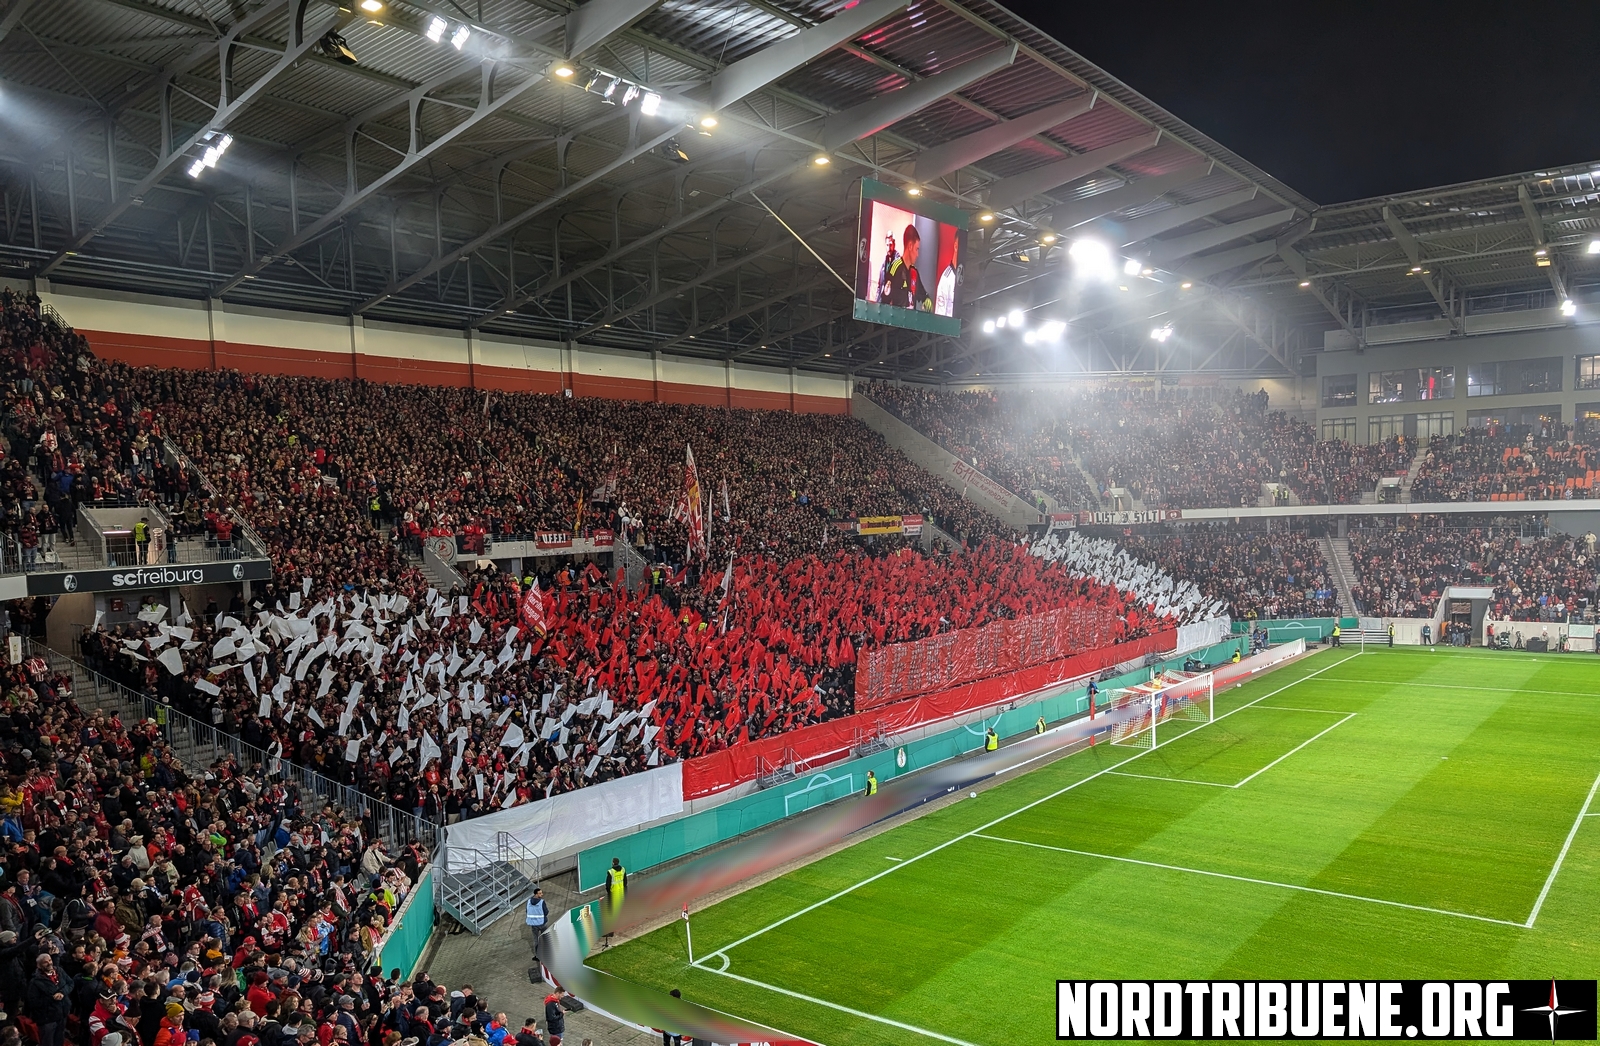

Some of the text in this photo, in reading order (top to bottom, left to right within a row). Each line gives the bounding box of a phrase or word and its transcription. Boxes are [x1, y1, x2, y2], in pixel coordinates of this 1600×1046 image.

[1095, 511, 1116, 523] LIST
[1133, 510, 1158, 523] SYLT
[867, 633, 958, 699] HEART
[976, 622, 1005, 668] OF
